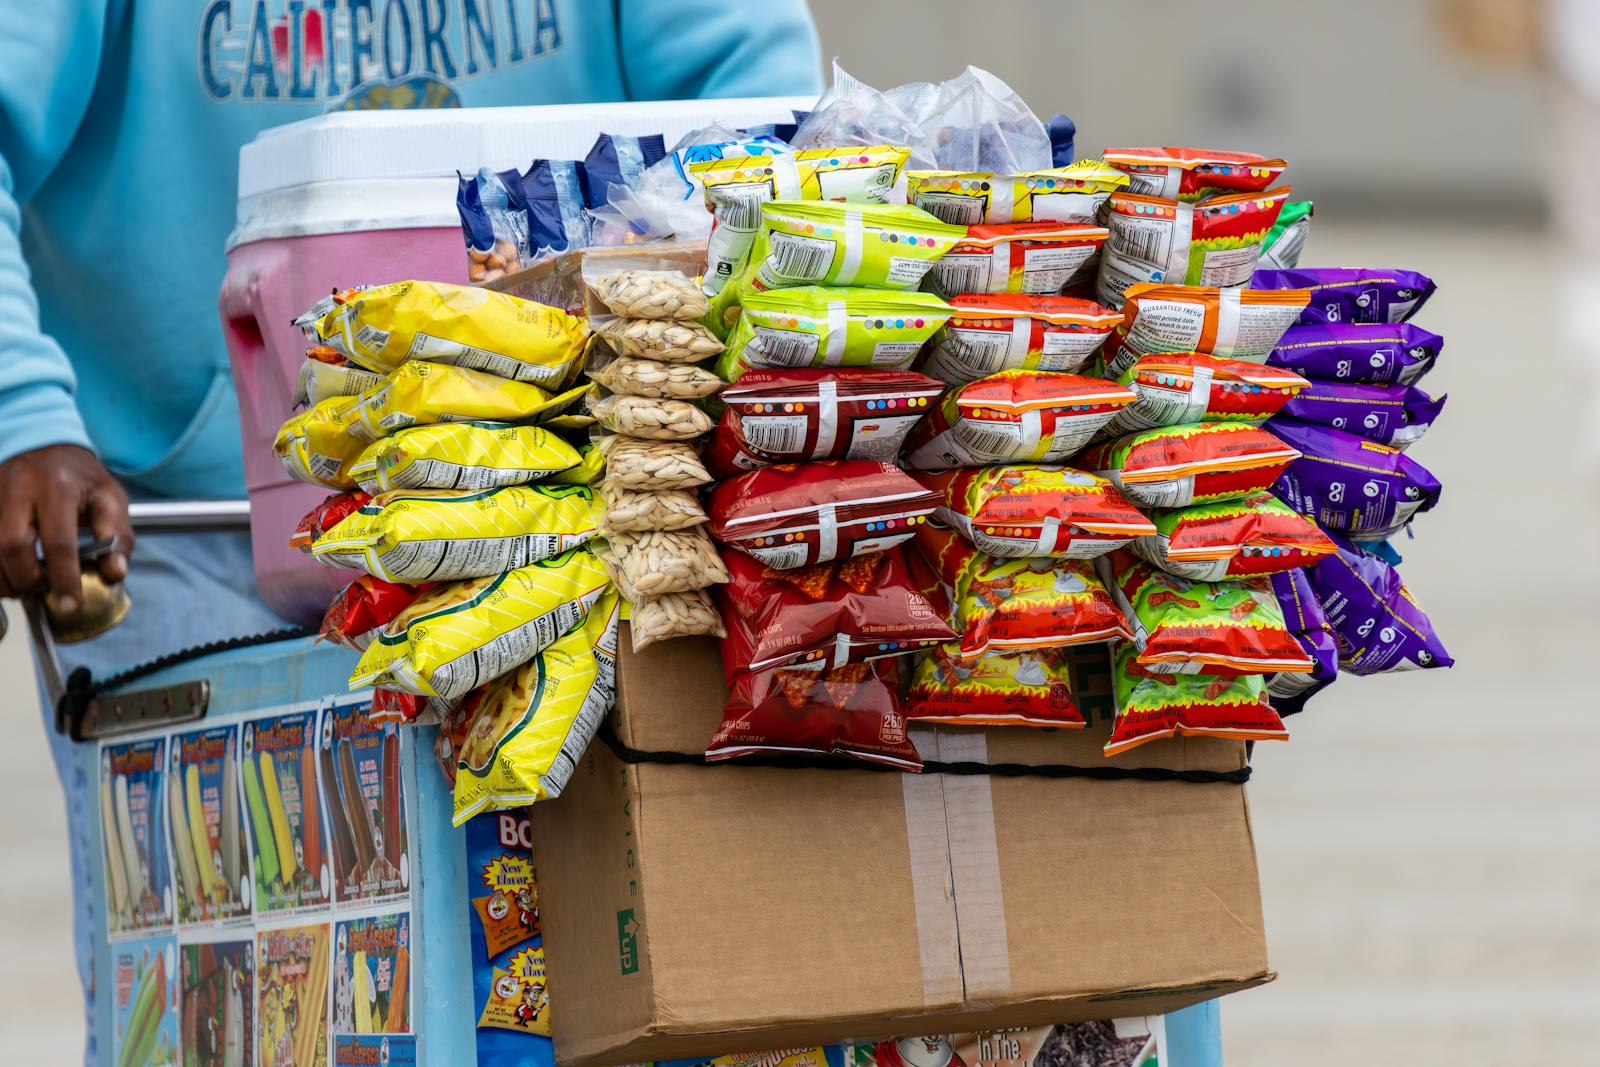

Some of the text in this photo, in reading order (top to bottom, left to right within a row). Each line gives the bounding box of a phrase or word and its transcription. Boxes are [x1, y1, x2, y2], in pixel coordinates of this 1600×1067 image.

[199, 0, 562, 100] CALIFORNIA
[1143, 303, 1202, 318] GUARANTEED FRESH
[1161, 315, 1182, 323] printed
[500, 863, 523, 874] New
[977, 1032, 1021, 1061] In The
